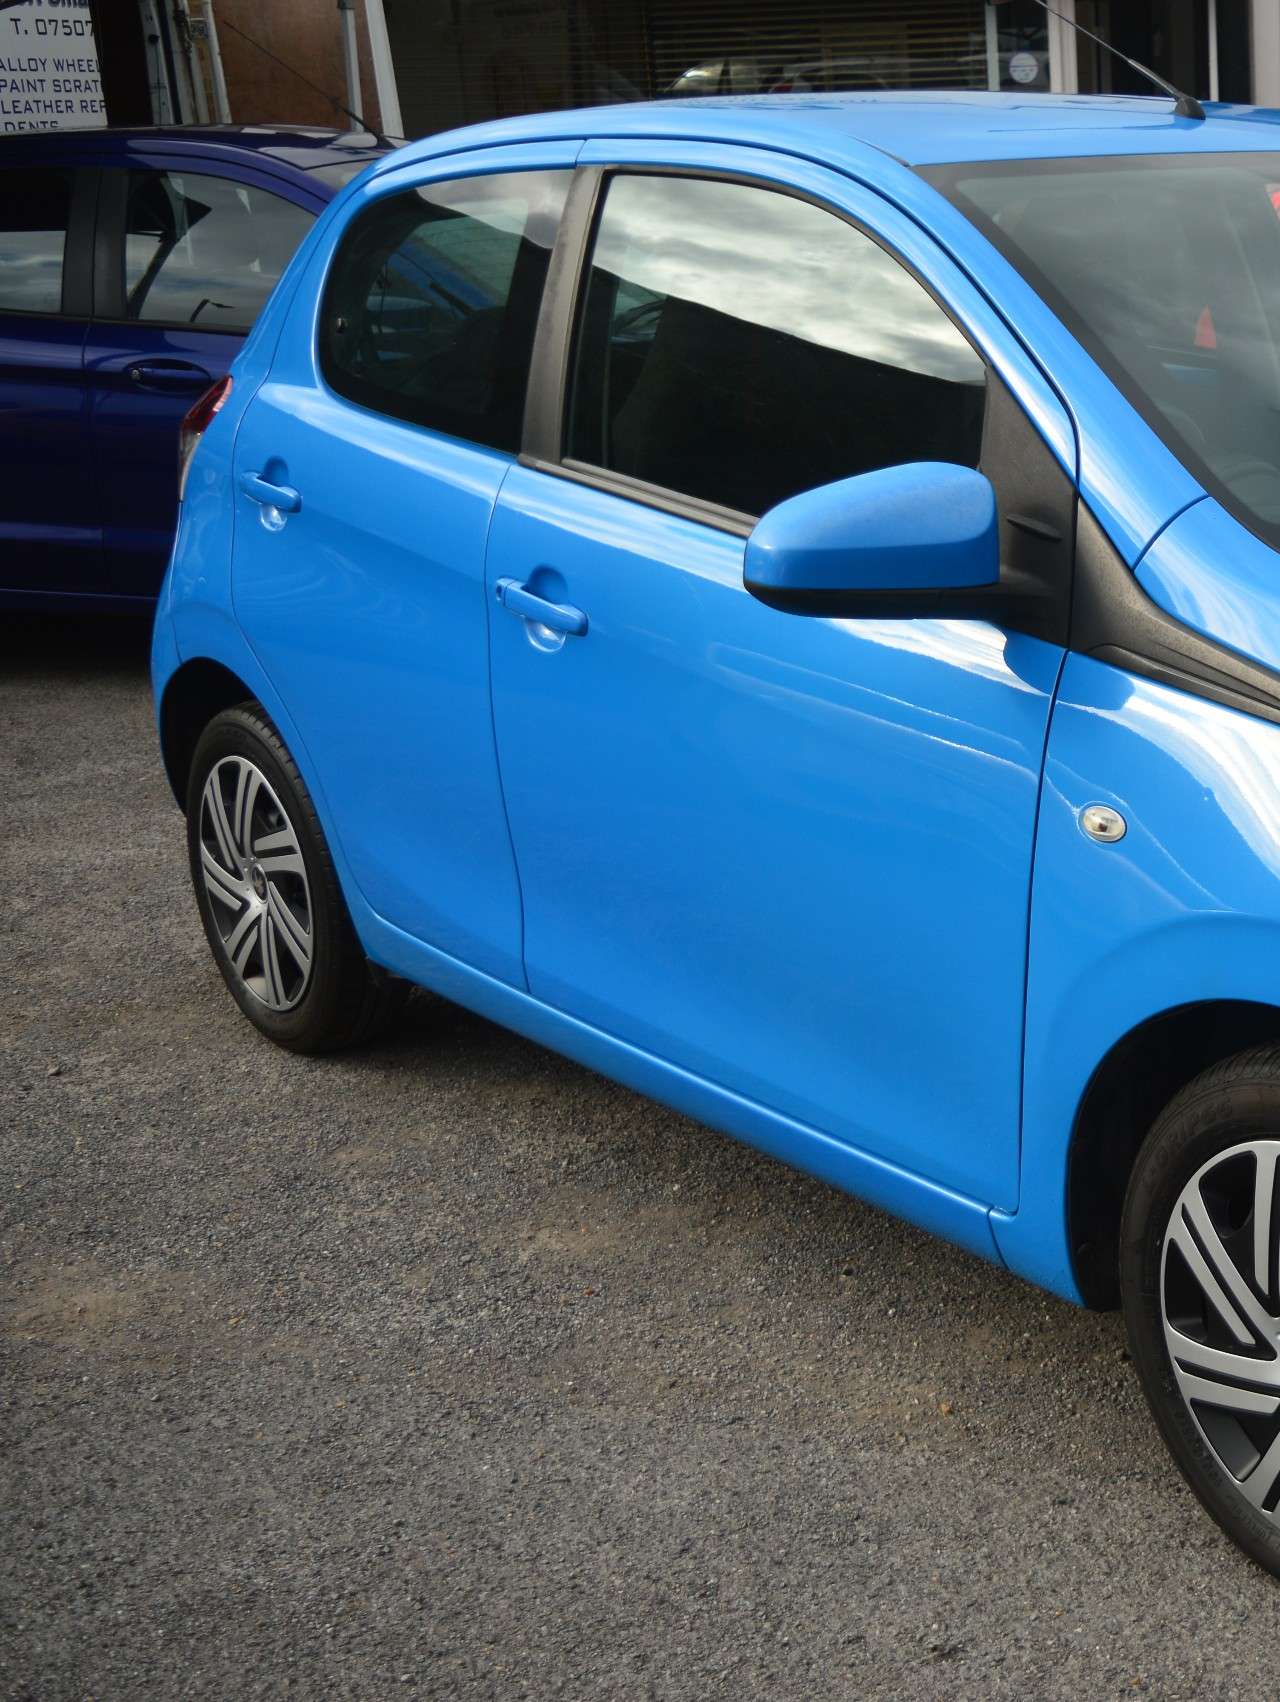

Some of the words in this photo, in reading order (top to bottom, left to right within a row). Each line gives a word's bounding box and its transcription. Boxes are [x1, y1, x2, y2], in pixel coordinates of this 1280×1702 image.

[9, 17, 29, 36] T.
[0, 57, 47, 72] ALLOY
[0, 79, 46, 93] PAINT
[1, 99, 75, 114] LEATHER
